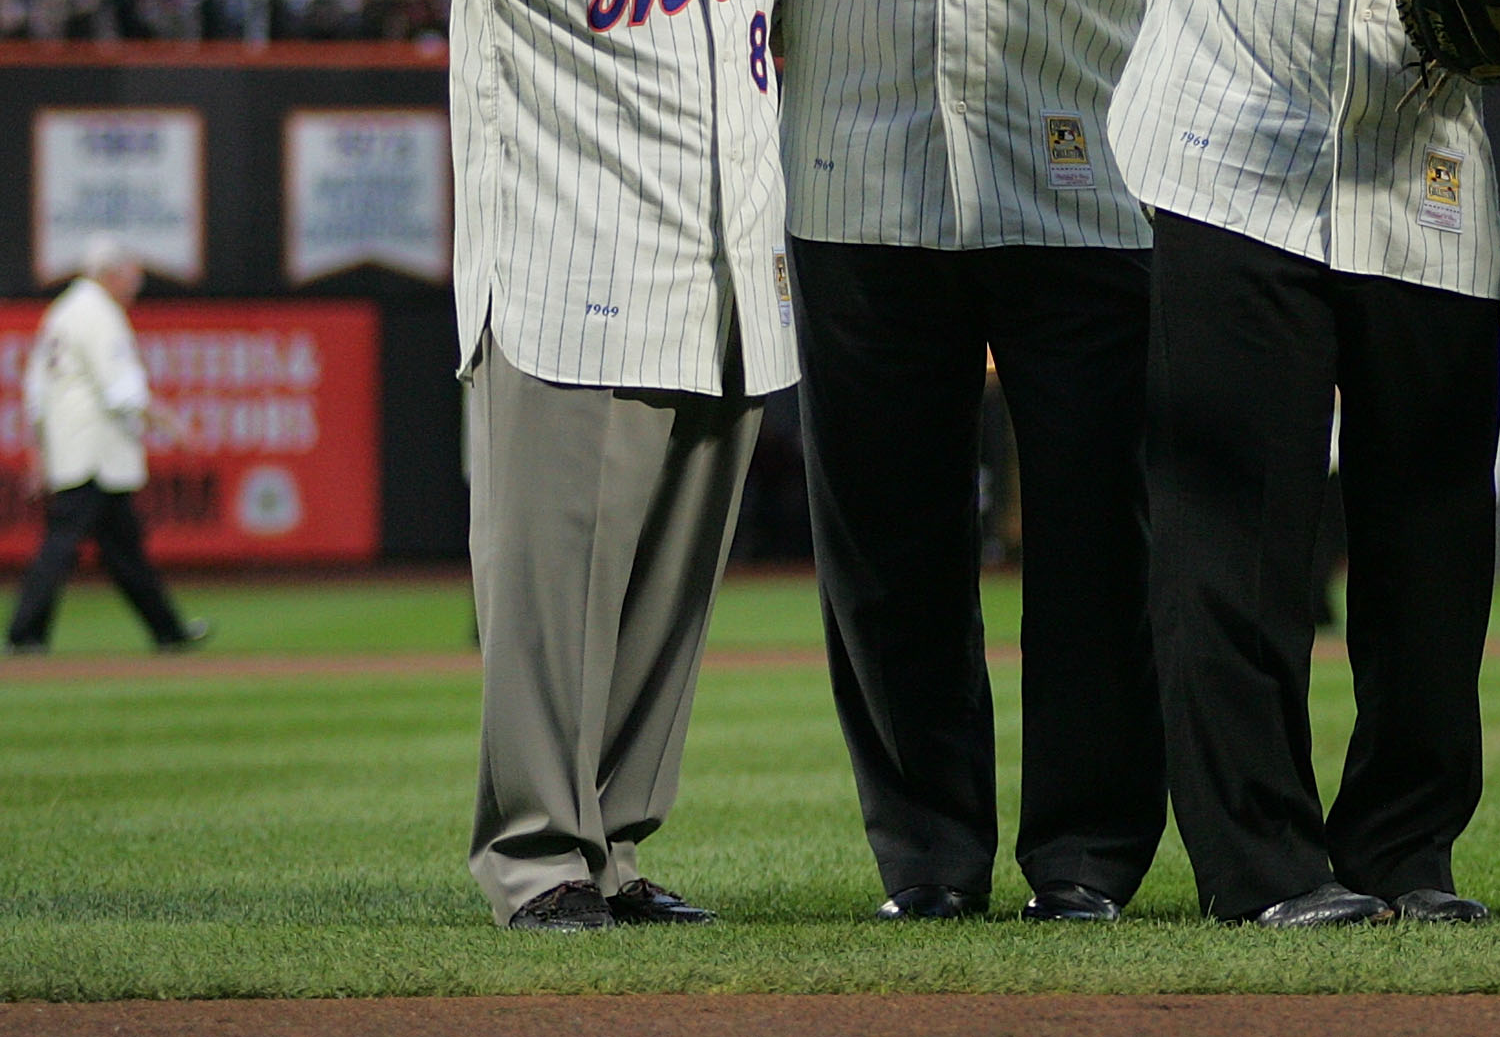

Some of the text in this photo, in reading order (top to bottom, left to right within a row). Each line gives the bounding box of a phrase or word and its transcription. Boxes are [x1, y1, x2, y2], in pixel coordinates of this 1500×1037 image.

[749, 10, 768, 95] 8
[1180, 131, 1209, 149] 1969
[586, 304, 619, 318] 1969
